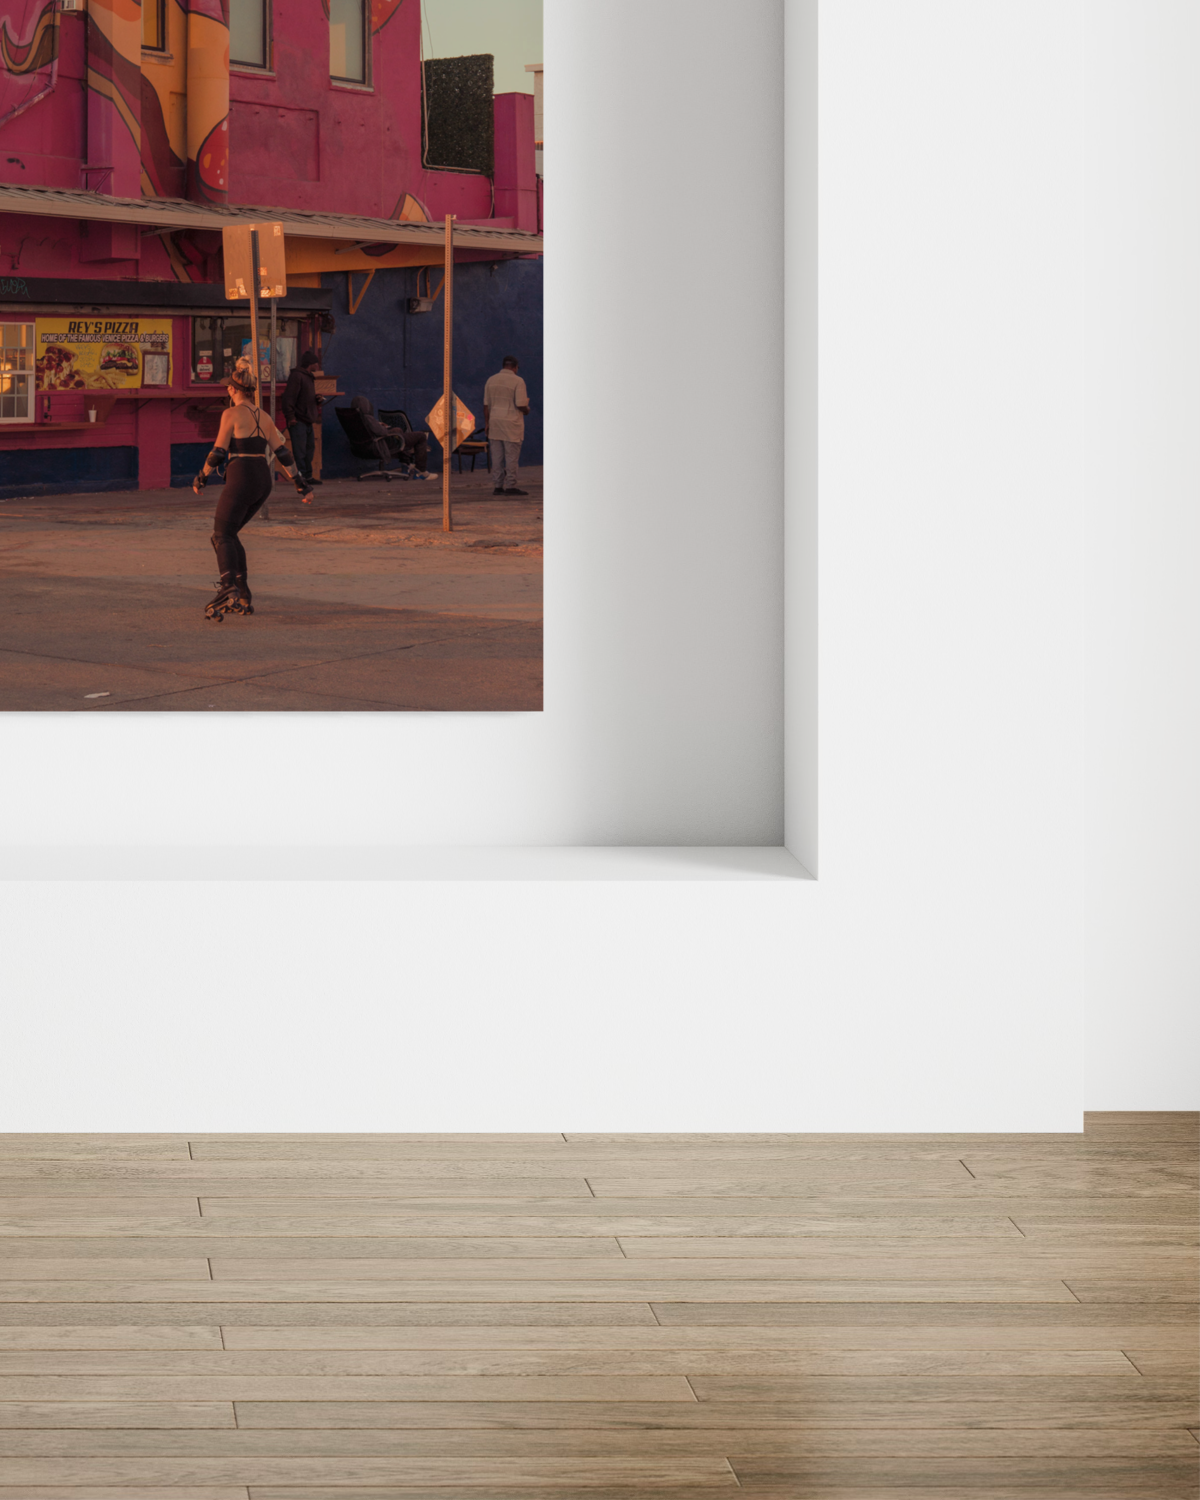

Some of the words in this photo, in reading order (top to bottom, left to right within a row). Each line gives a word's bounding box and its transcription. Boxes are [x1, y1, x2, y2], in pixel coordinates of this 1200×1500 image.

[68, 321, 103, 333] REY'S
[104, 322, 139, 333] PIZZA
[41, 334, 58, 343] HOME
[58, 334, 67, 343] OF
[67, 334, 79, 343] THE
[79, 334, 101, 343] FAMOUS
[102, 334, 121, 343] VENICE
[122, 334, 139, 343] PIZZA
[140, 334, 145, 343] &
[145, 334, 169, 343] BURGERS
